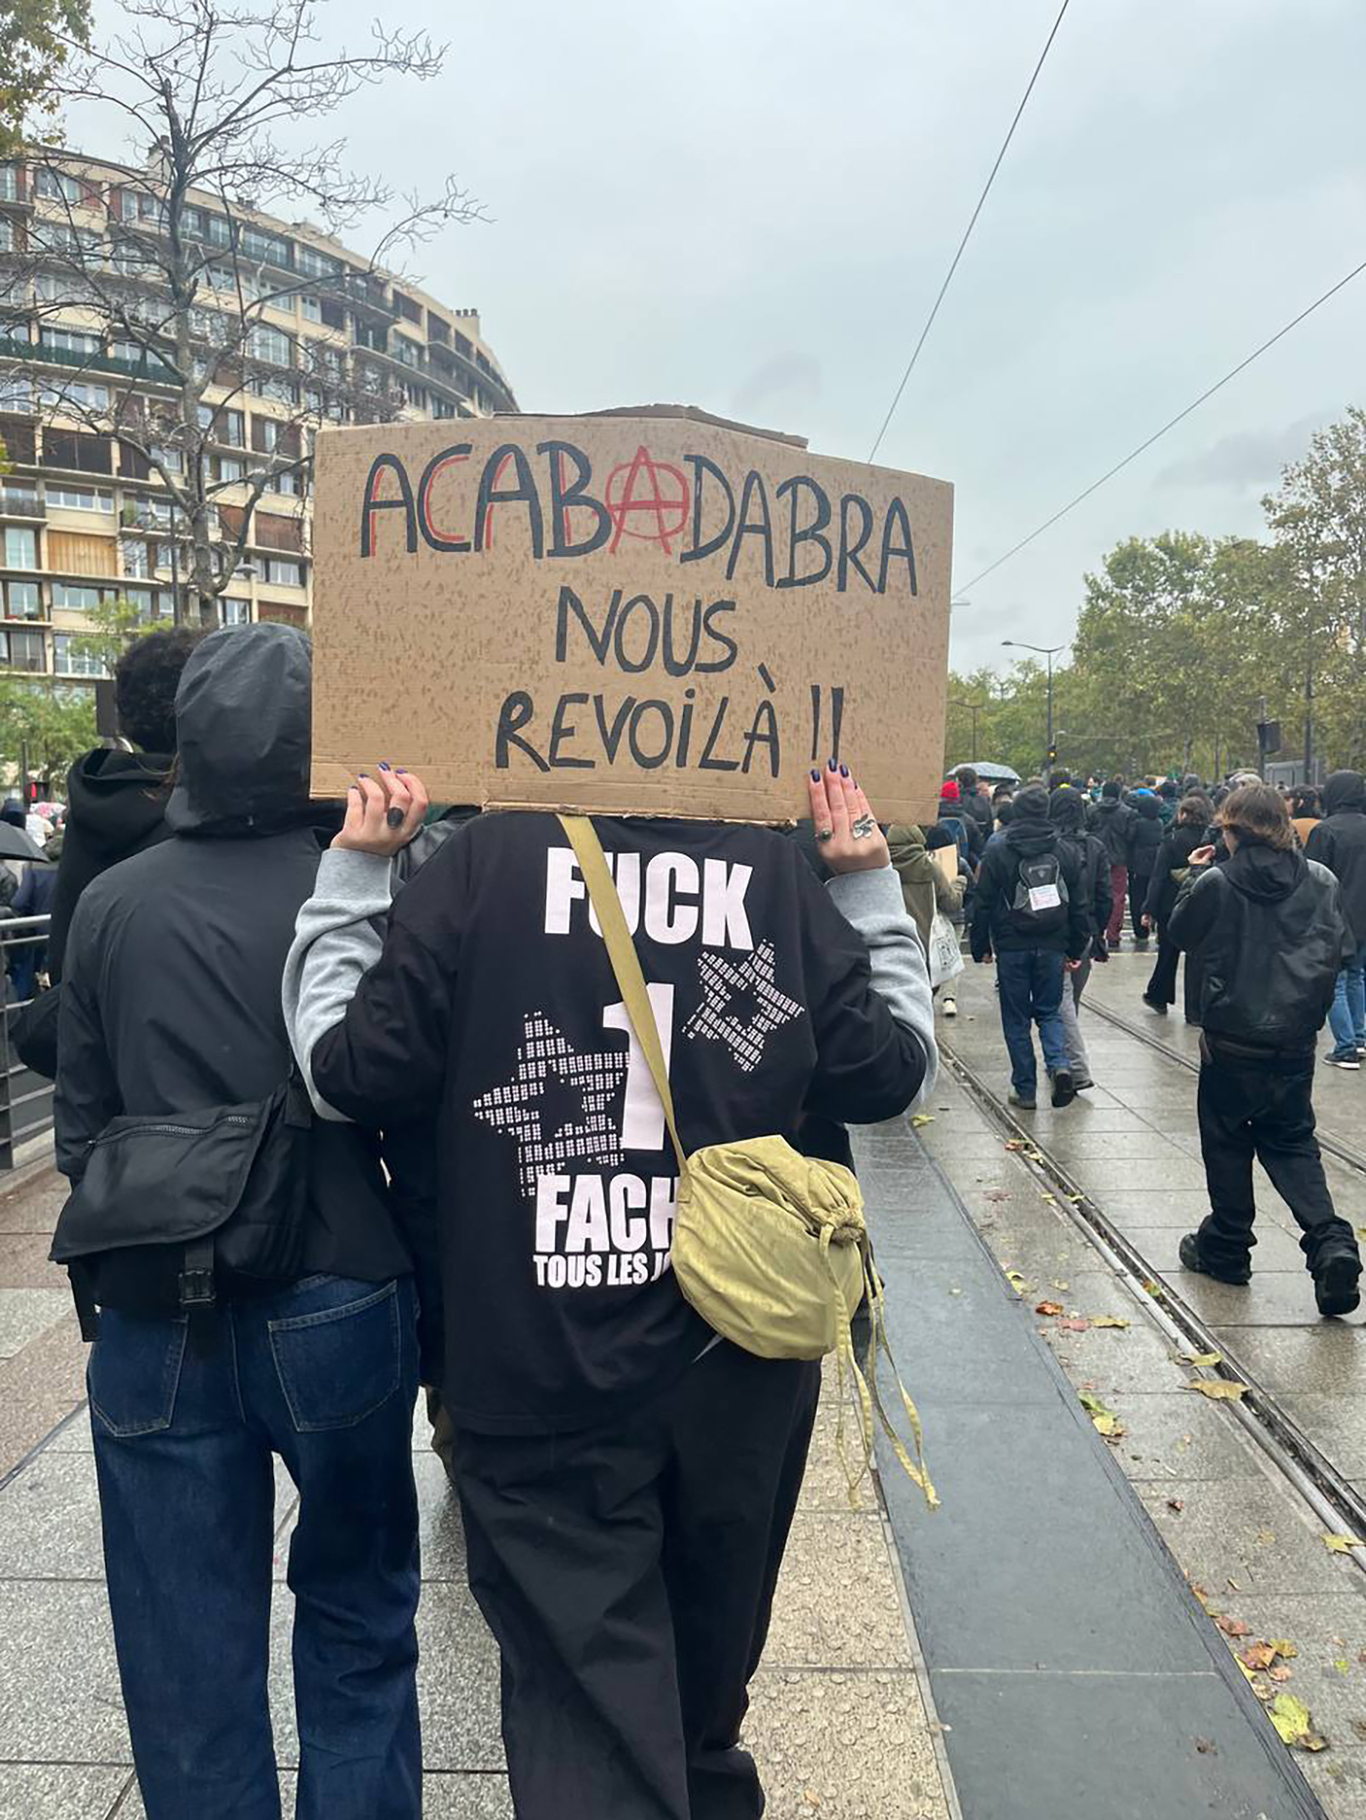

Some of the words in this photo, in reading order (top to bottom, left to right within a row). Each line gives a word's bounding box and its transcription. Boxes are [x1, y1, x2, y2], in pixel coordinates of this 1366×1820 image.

[360, 439, 919, 596] ACABADABRA
[555, 585, 738, 677] NOUS
[544, 847, 755, 951] FUCK
[602, 982, 675, 1151] 1
[535, 1173, 680, 1252] FACH
[533, 1254, 602, 1288] TOUS
[607, 1252, 649, 1285] LES
